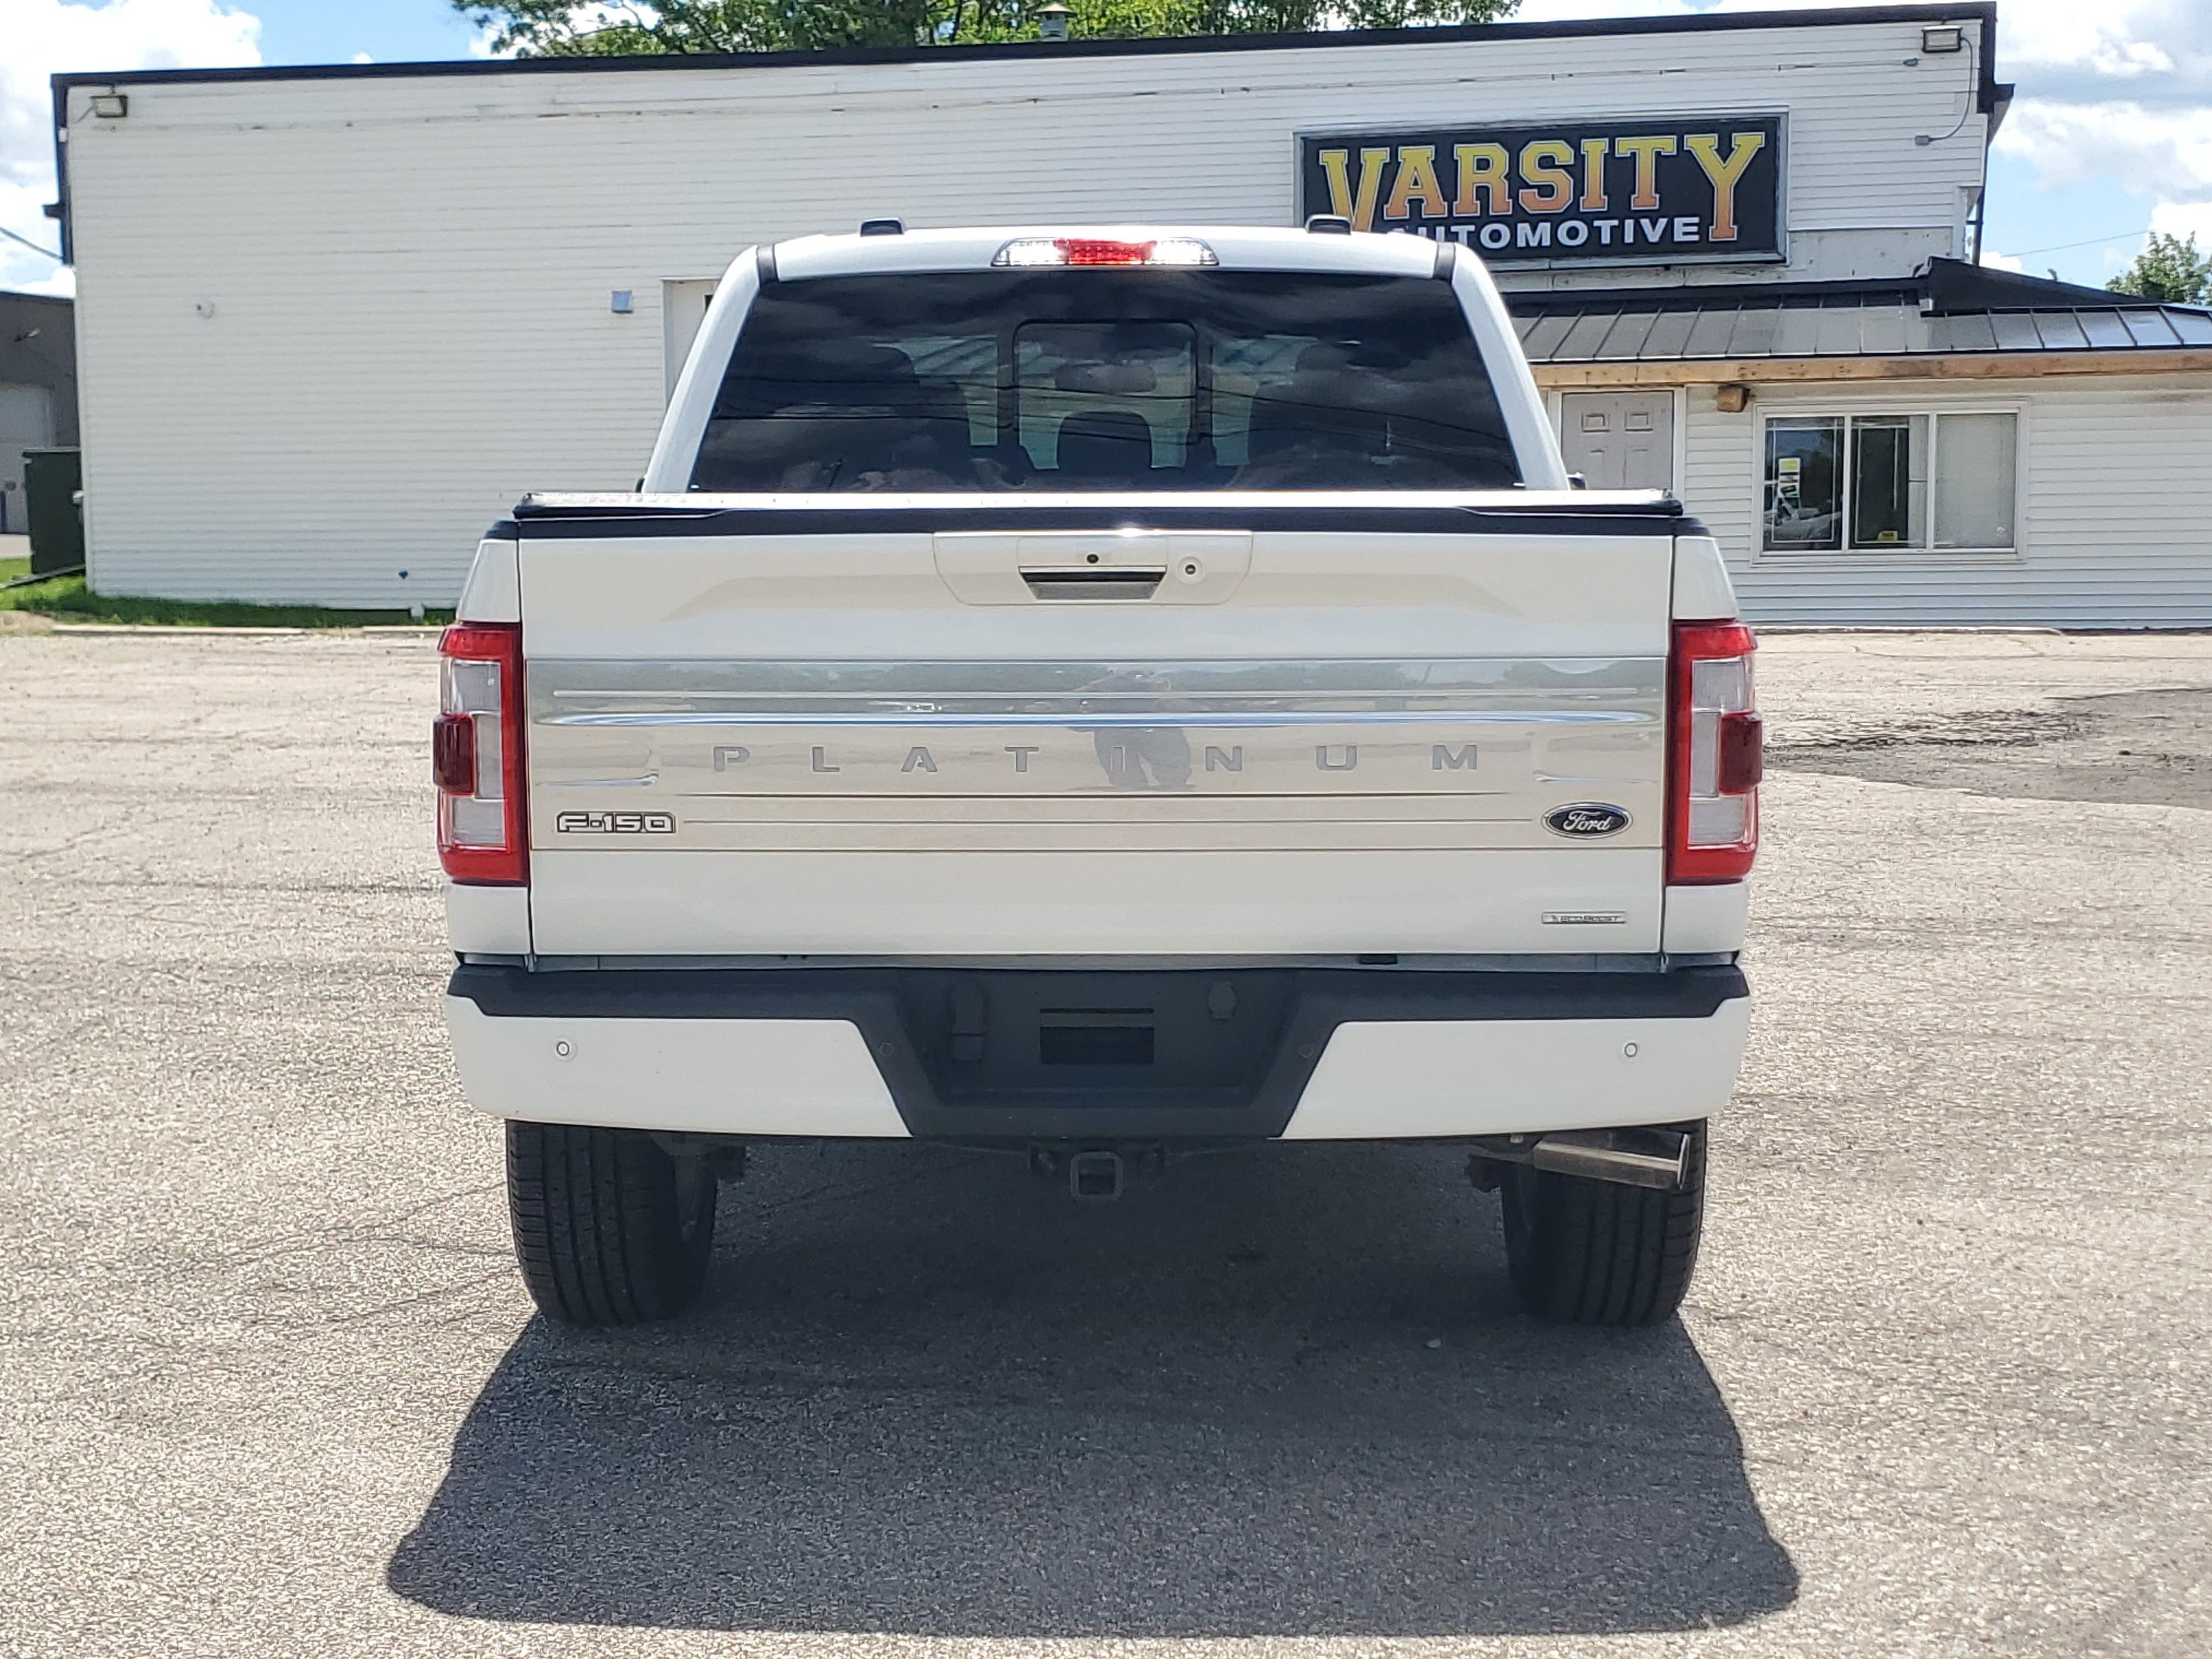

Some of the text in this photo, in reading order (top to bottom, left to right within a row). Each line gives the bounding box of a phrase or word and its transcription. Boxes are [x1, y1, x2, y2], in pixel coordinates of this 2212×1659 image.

[1319, 131, 1765, 242] VARSITY
[1390, 216, 1701, 250] TOMOTIVE
[713, 744, 1477, 772] PLATINUM
[556, 811, 675, 833] F-150
[1563, 810, 1613, 831] Ford
